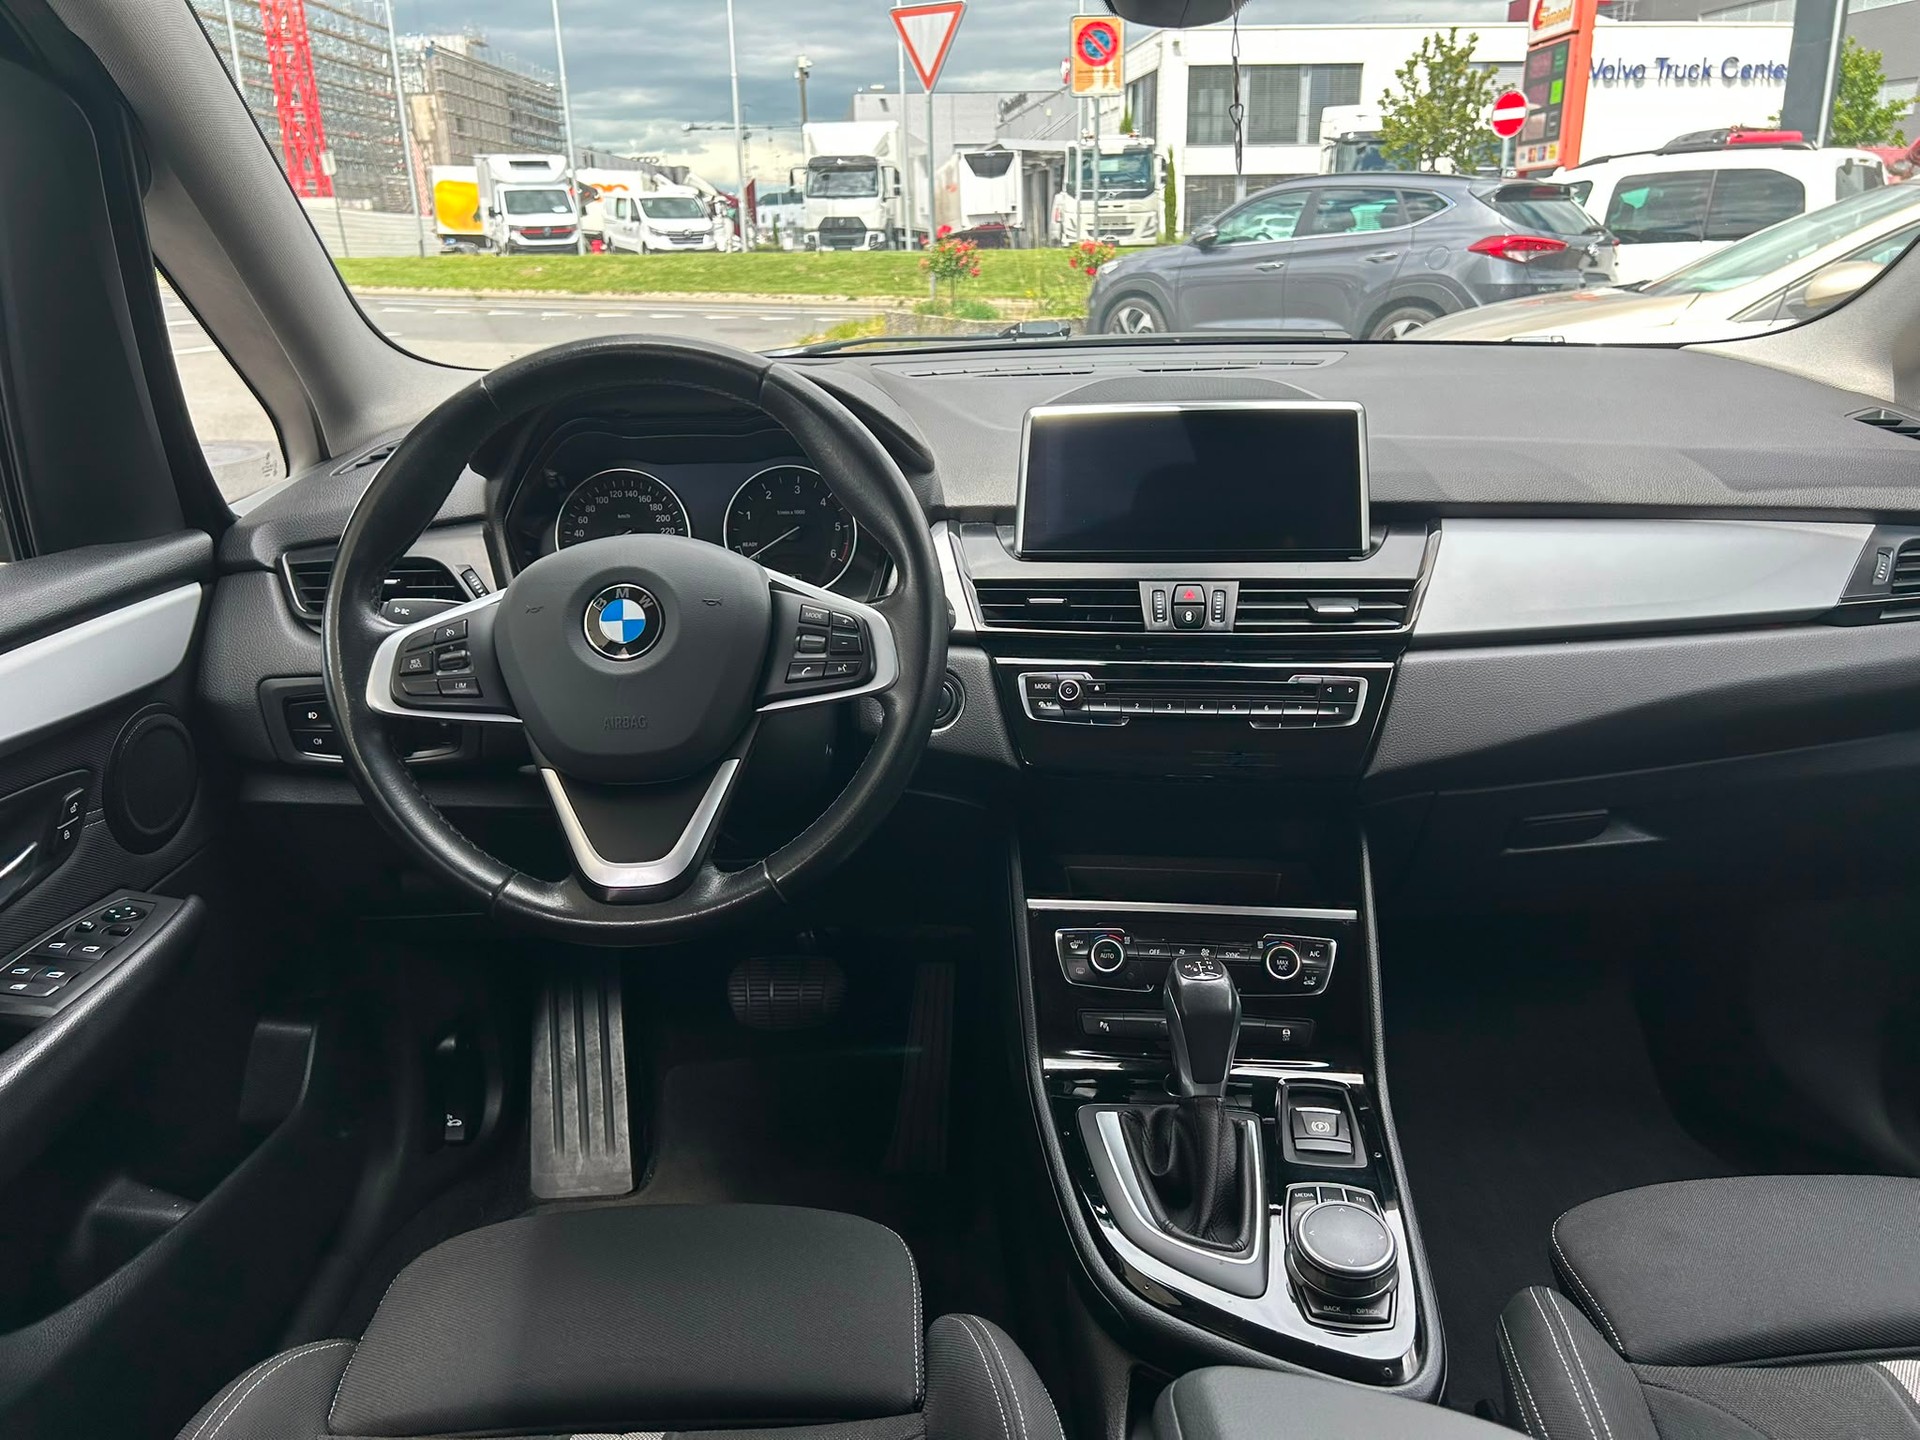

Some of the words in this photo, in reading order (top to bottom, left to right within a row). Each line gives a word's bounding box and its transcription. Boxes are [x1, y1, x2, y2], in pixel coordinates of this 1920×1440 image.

[1590, 57, 1646, 80] Volvo
[1655, 57, 1712, 80] Truck
[609, 490, 623, 498] 120
[624, 490, 638, 498] 140
[794, 485, 801, 495] 3
[638, 495, 652, 503] 160
[765, 490, 772, 500] 2
[595, 496, 609, 504] 100
[820, 497, 827, 507] 4
[585, 504, 596, 513] 80
[649, 503, 663, 511] 180
[655, 514, 671, 522] 200
[746, 511, 751, 520] 1
[577, 516, 589, 524] 60
[834, 522, 841, 531] 5
[660, 527, 676, 535] 220
[830, 549, 837, 558] 6
[603, 714, 648, 730] AIRBAG
[1309, 950, 1321, 958] A/C
